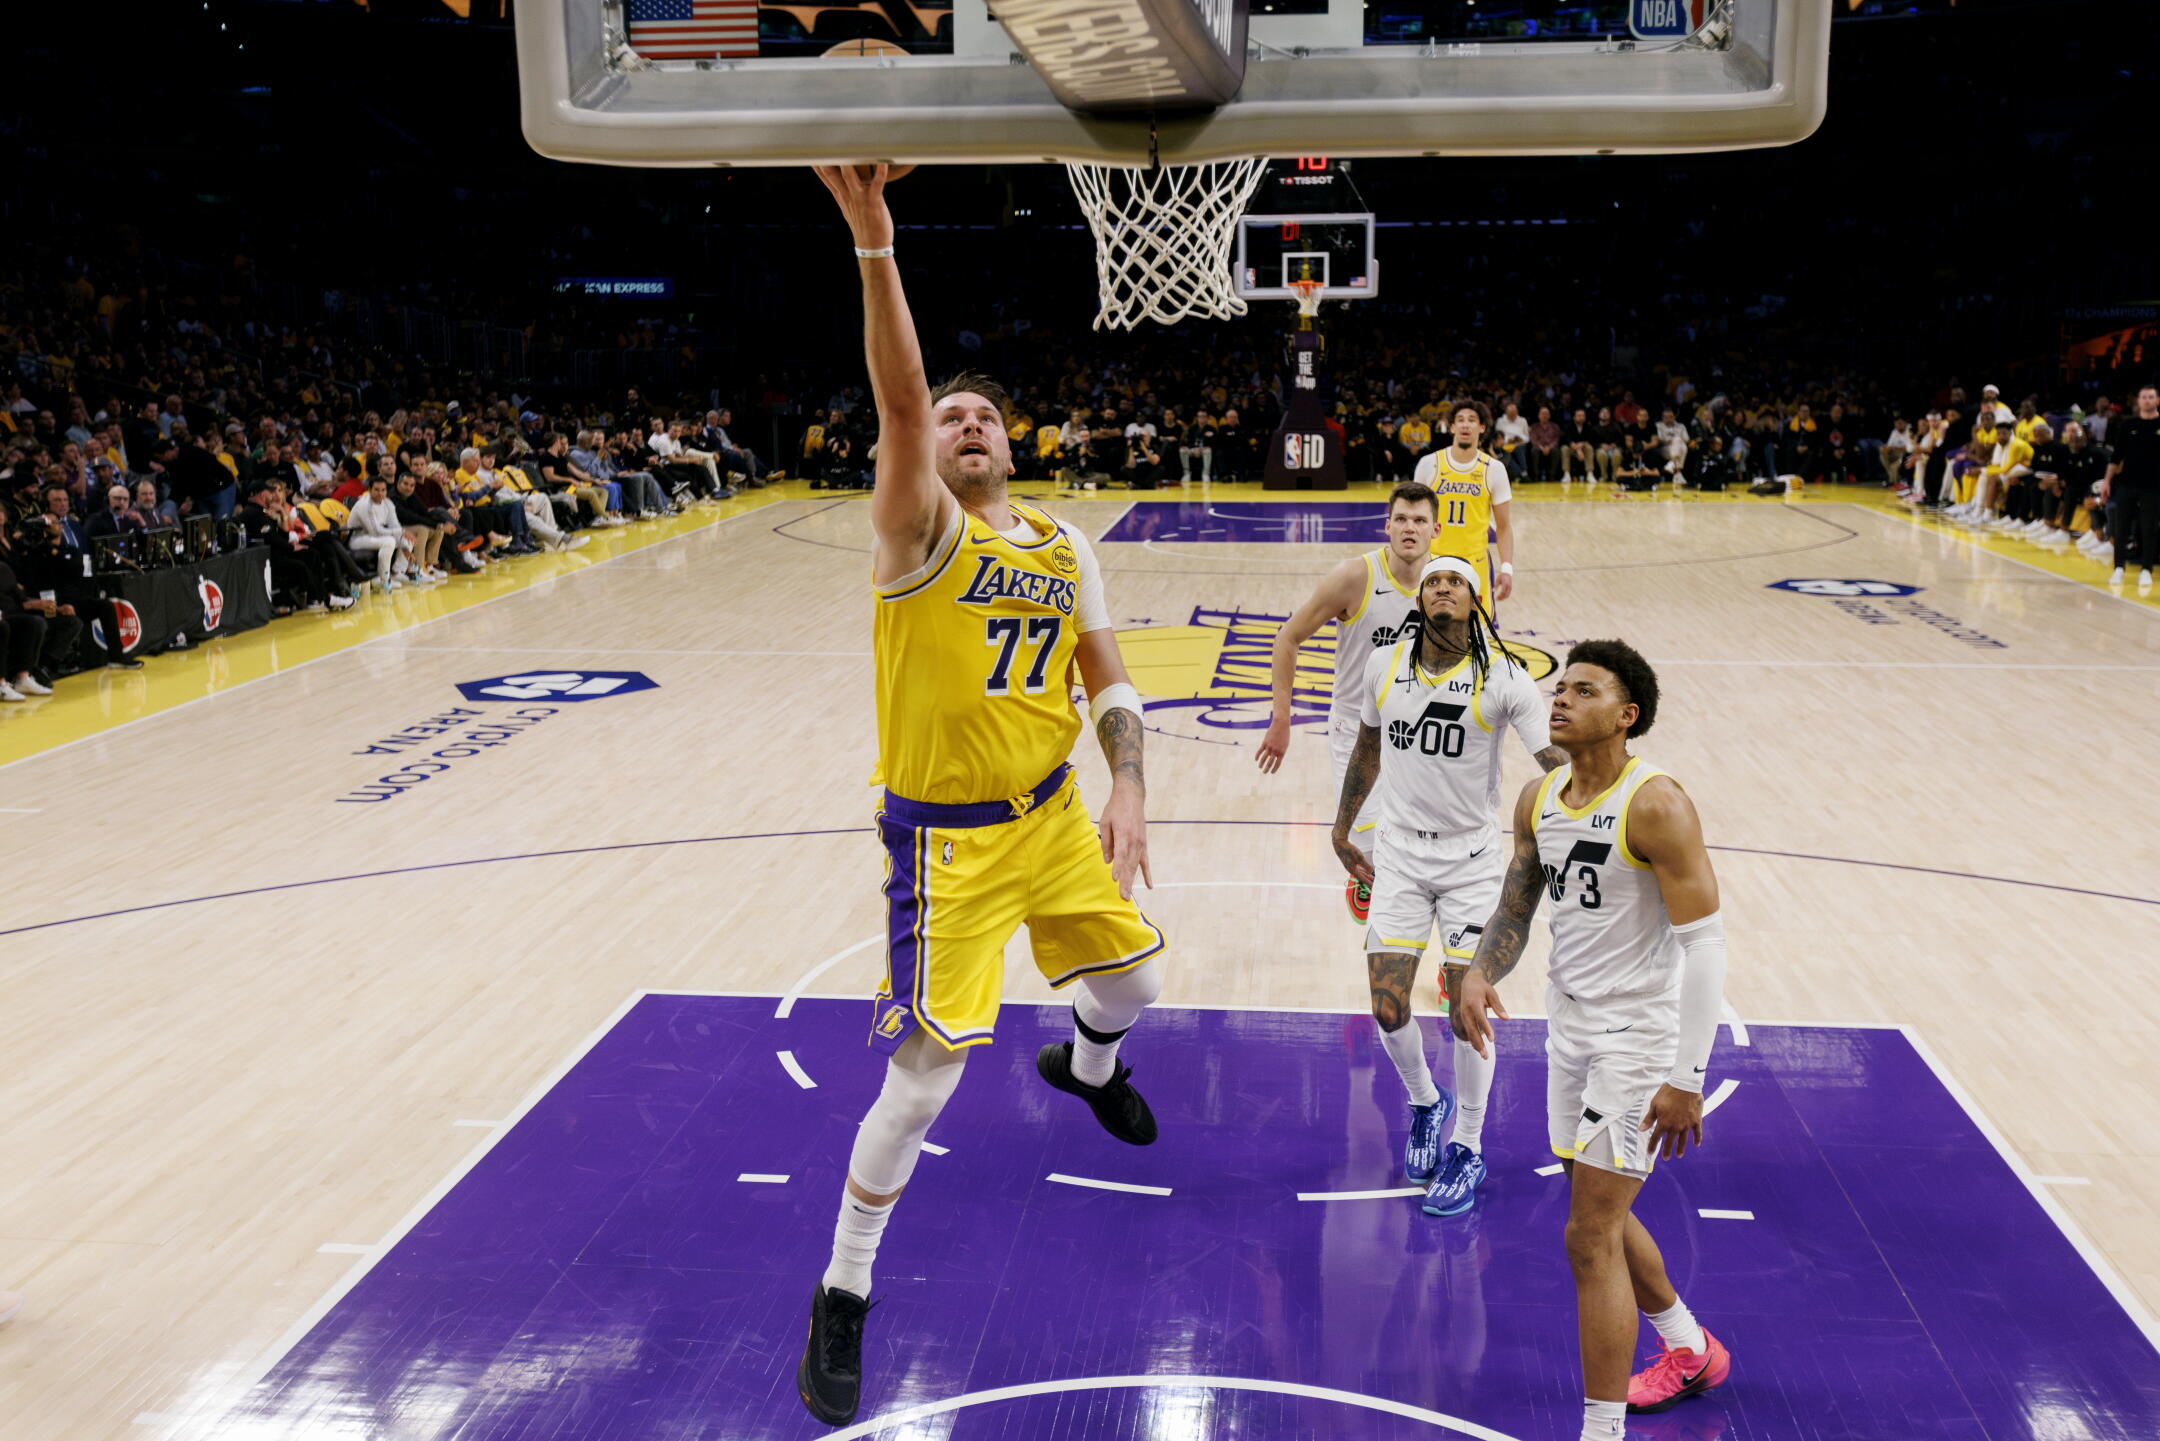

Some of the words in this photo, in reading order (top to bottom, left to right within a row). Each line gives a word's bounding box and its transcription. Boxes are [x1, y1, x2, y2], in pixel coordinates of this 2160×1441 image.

[1641, 0, 1677, 27] NBA
[1294, 175, 1334, 185] TISSOT
[613, 282, 664, 294] EXPRESS
[1298, 351, 1313, 363] GET
[1436, 478, 1482, 497] LAKERS
[1446, 499, 1466, 527] 11
[954, 554, 1077, 617] LAKERS
[985, 616, 1062, 697] 77
[1448, 680, 1472, 694] LVT
[352, 707, 486, 756] ARENA
[1420, 719, 1466, 758] 00
[1591, 814, 1616, 830] LVT
[1578, 866, 1602, 909] 3
